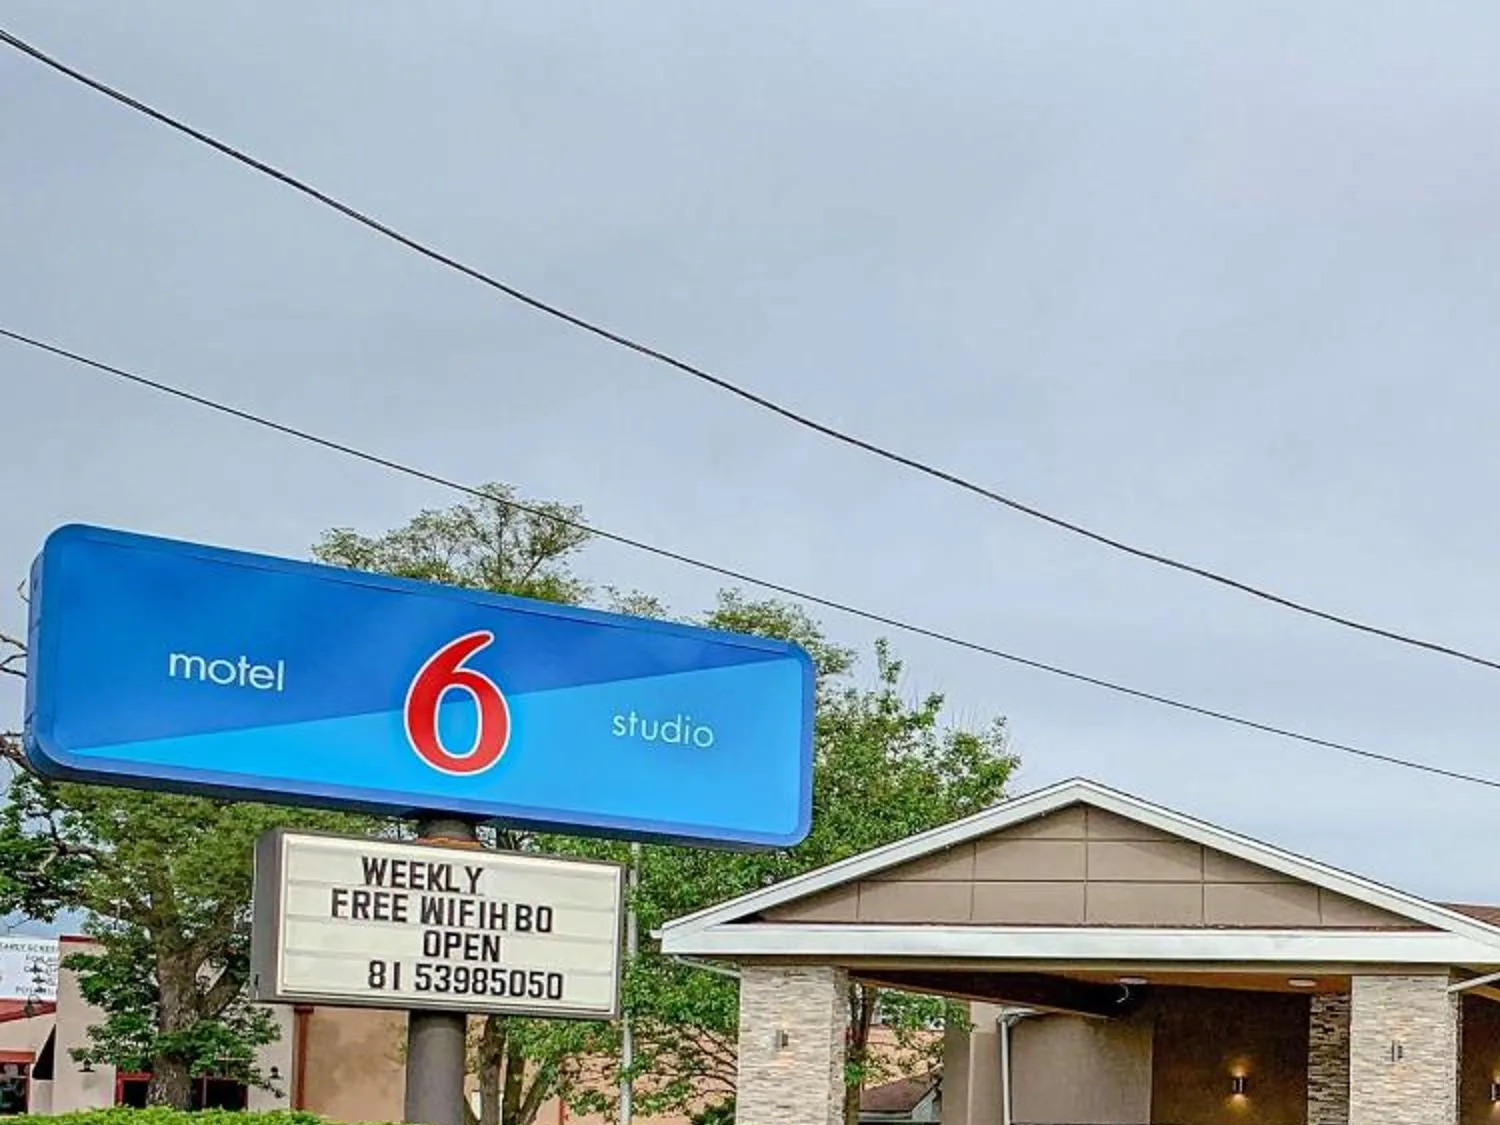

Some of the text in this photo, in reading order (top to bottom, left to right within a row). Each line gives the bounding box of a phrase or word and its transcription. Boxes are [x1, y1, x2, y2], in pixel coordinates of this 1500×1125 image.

[168, 629, 715, 777] motel 6 studio
[361, 856, 485, 895] WEEKLY
[330, 888, 409, 924] FREE
[422, 929, 502, 963] OPEN
